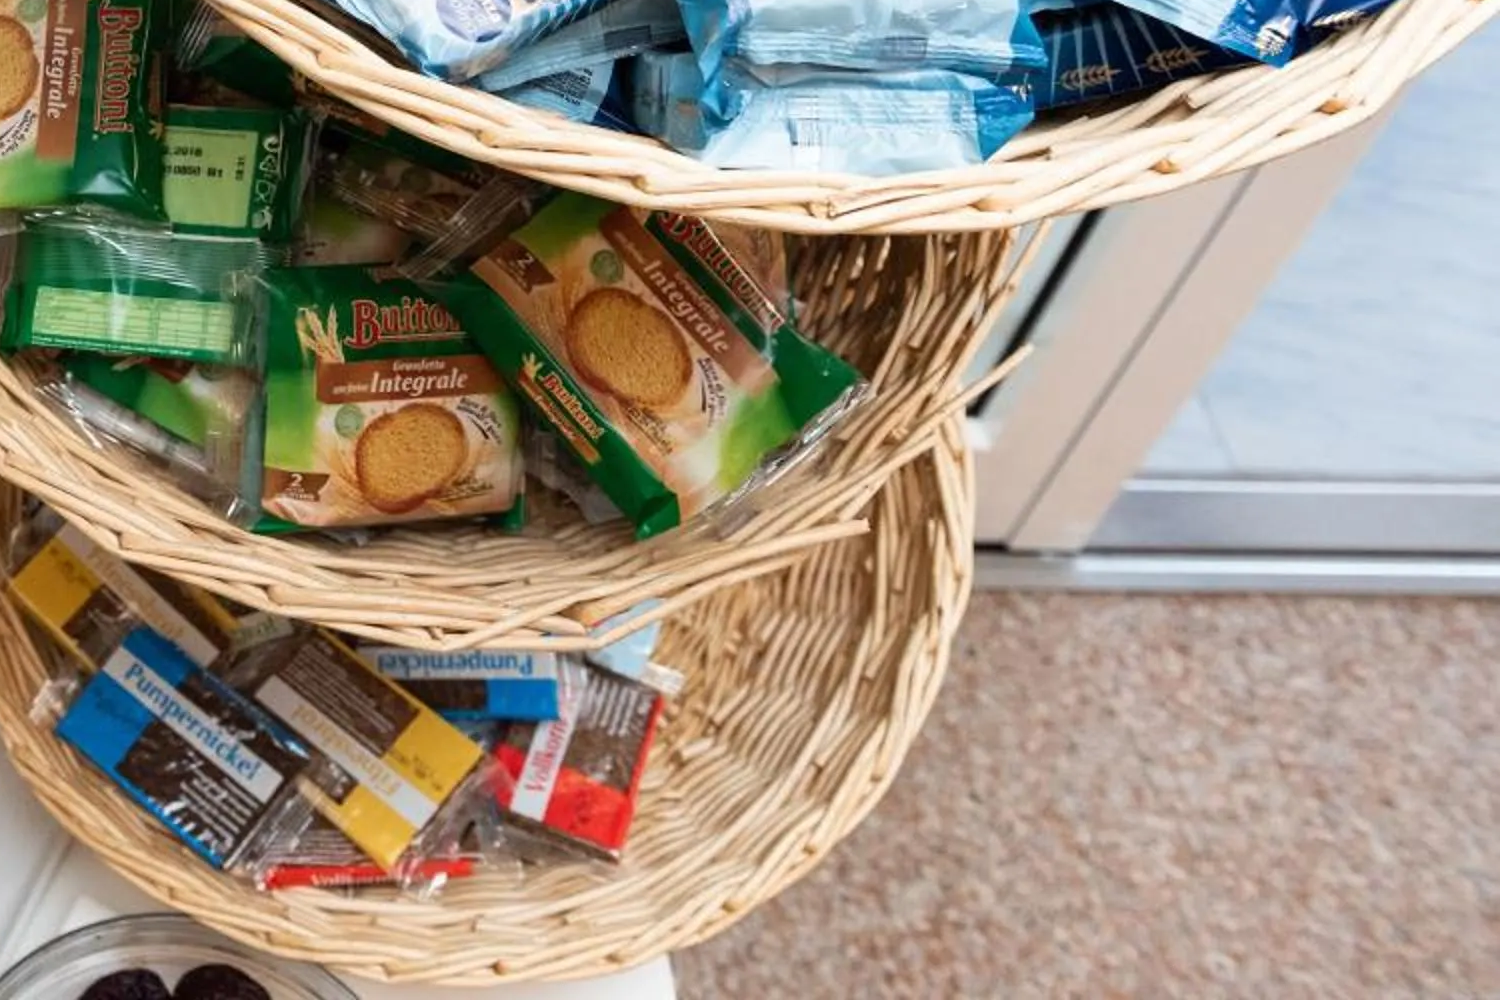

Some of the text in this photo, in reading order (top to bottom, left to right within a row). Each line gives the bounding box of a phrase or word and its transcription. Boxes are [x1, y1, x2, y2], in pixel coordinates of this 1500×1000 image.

[45, 27, 74, 119] Integrale
[94, 0, 143, 133] Buitoni
[343, 296, 466, 350] Buito
[642, 260, 732, 354] Integrale
[371, 368, 468, 396] Integrale
[291, 473, 303, 487] 2
[377, 651, 533, 678] Pumpernickel
[124, 663, 262, 781] Pumpernickel
